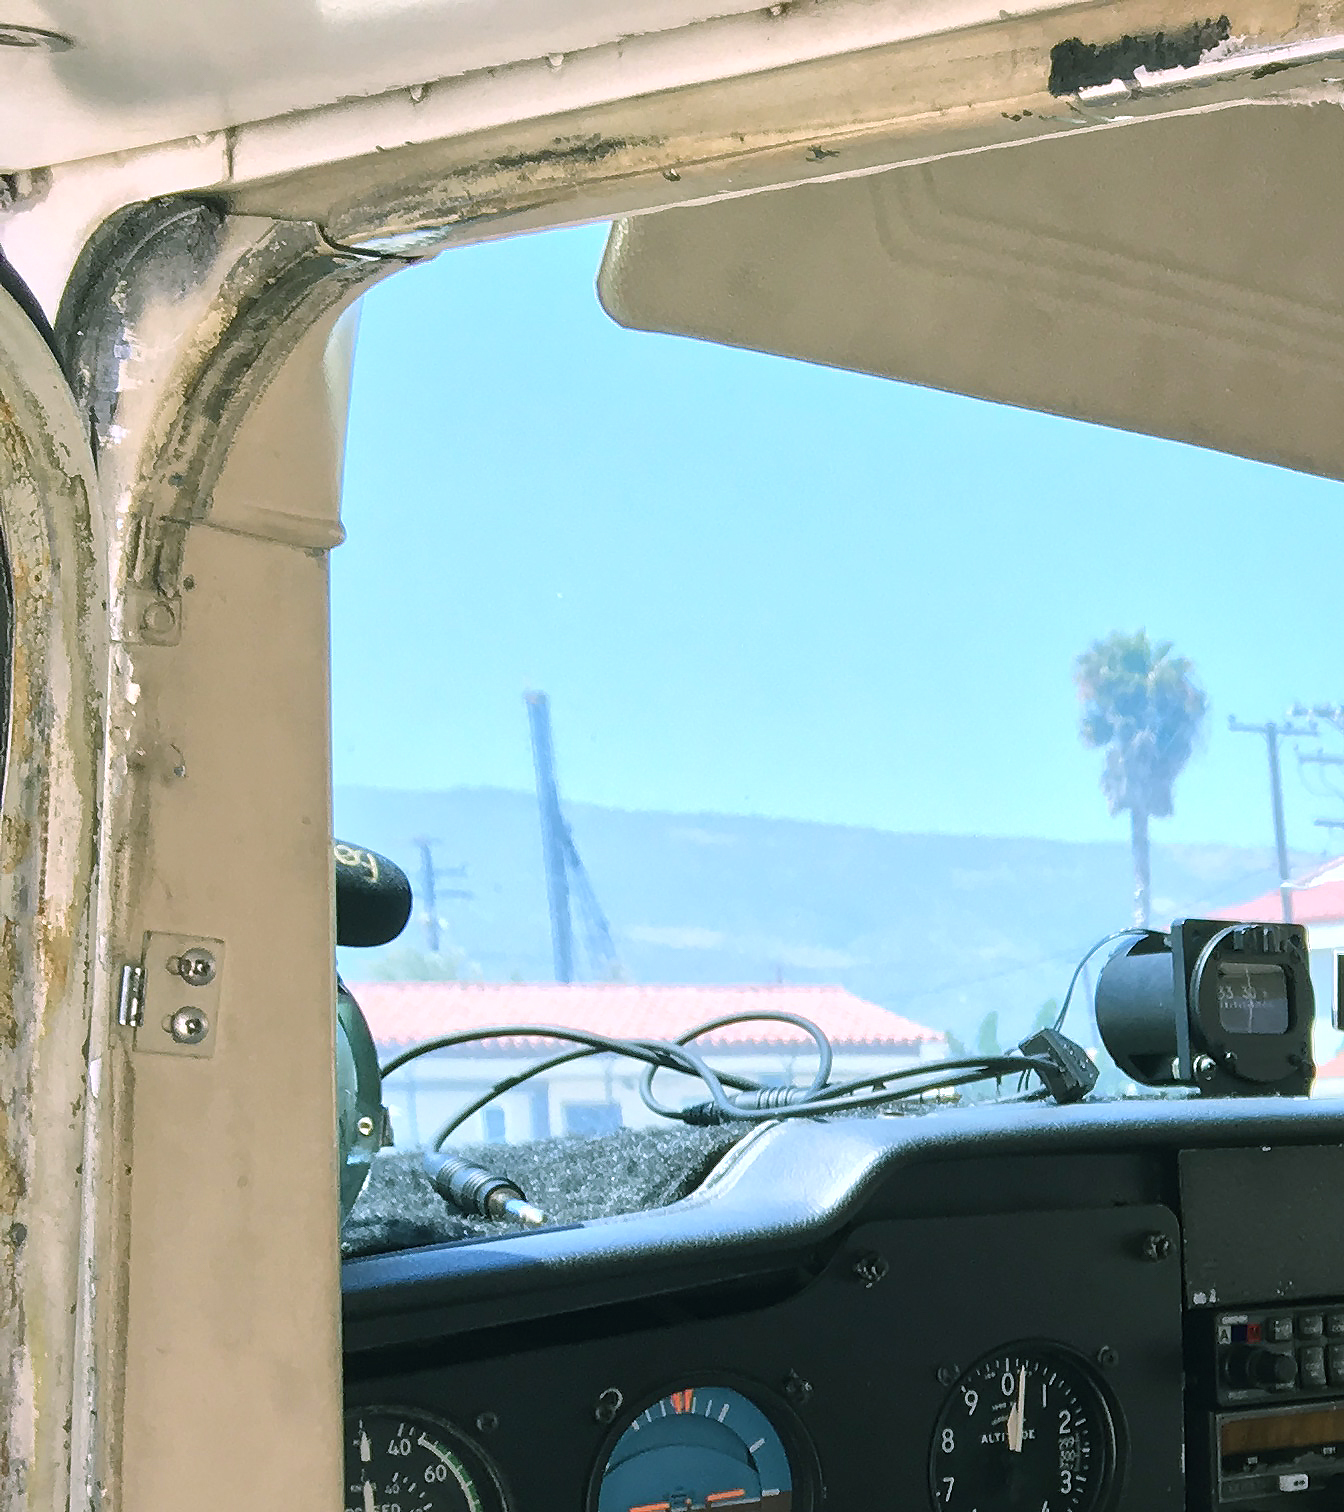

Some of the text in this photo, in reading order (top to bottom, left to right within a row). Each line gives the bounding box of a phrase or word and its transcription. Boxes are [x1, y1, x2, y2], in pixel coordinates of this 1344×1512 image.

[1001, 1371, 1015, 1397] 0
[963, 1389, 980, 1416] 9
[1058, 1409, 1073, 1435] 2
[387, 1437, 413, 1457] 40
[942, 1427, 955, 1454] 8
[424, 1463, 449, 1484] 60
[1060, 1469, 1073, 1495] 3
[942, 1476, 955, 1503] 7
